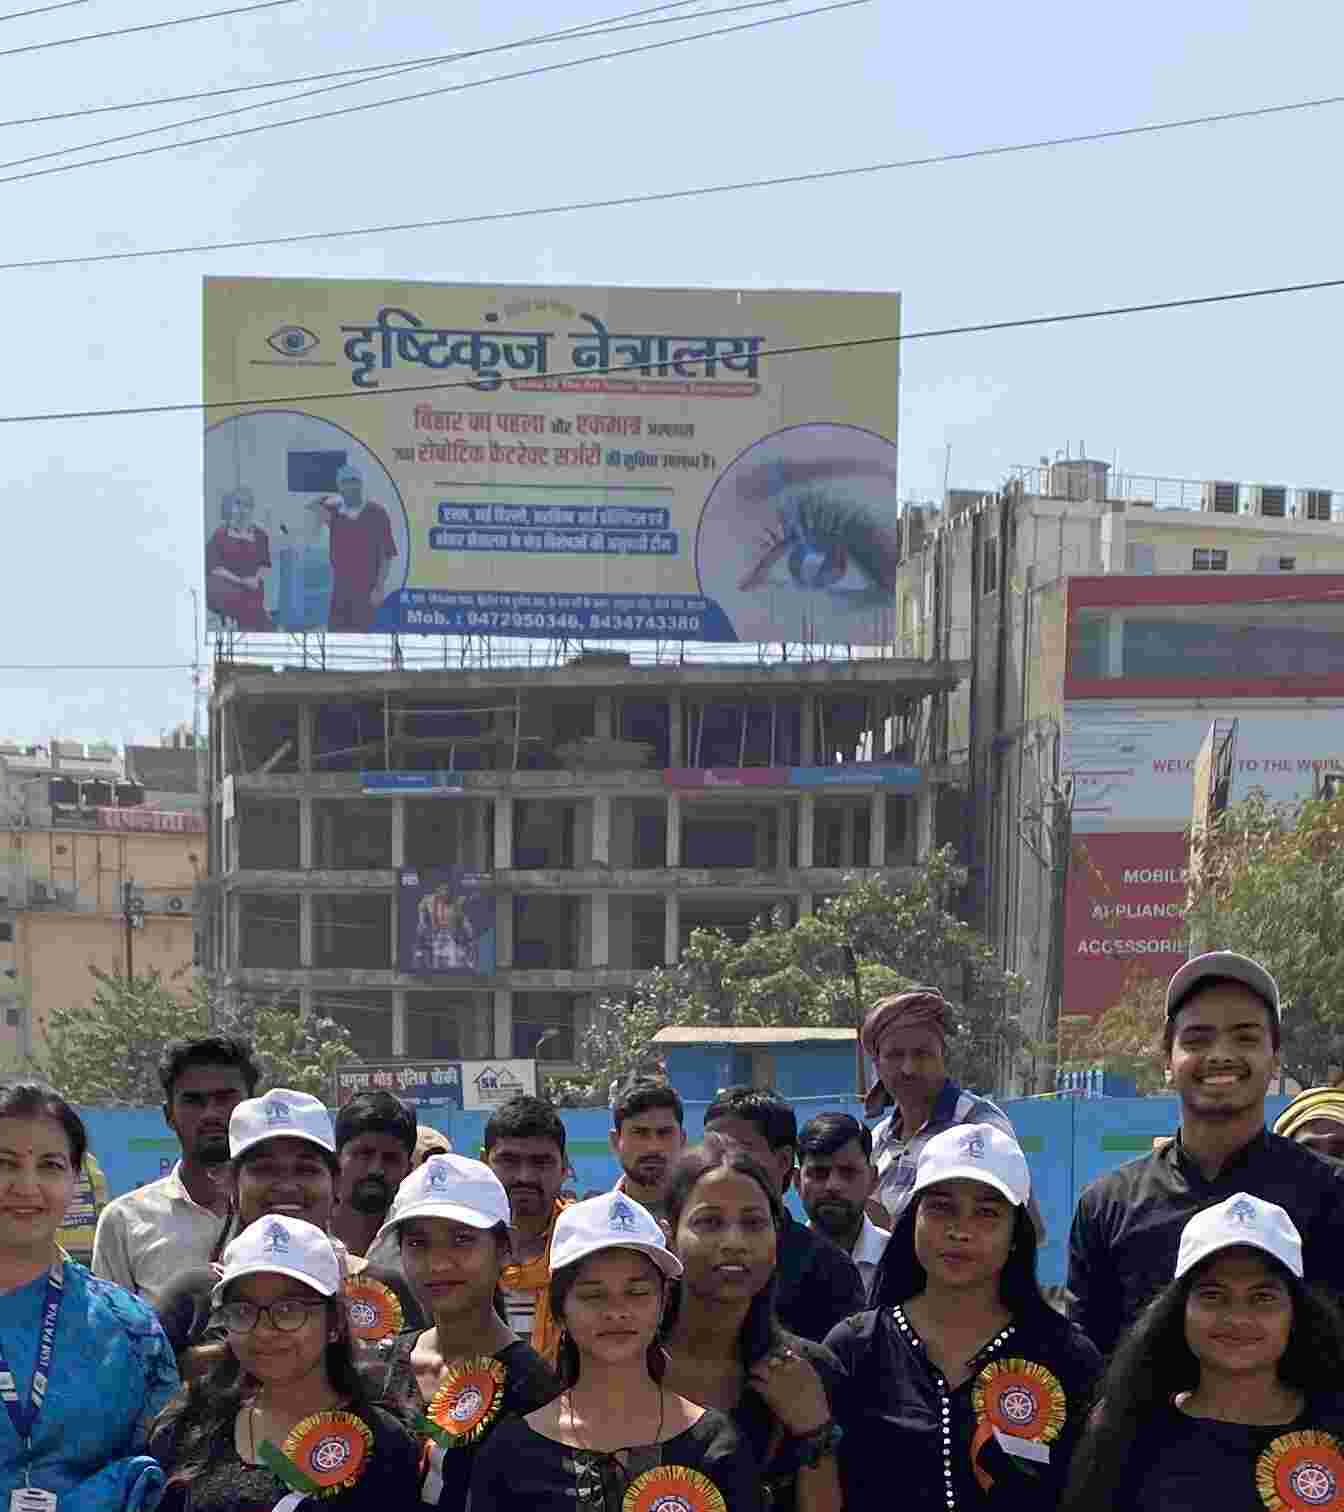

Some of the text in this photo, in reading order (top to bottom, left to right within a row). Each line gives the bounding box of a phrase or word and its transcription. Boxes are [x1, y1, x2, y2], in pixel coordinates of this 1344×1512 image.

[340, 307, 766, 391] दृष्टिकुंज नेत्रालय
[414, 401, 462, 433] बिहार
[468, 411, 492, 433] का
[495, 412, 545, 434] पहला
[551, 417, 572, 437] और
[575, 413, 641, 436] एकमात्र
[417, 436, 485, 465] रोबोटिक
[554, 441, 601, 466] सर्जरी
[407, 610, 449, 625] Mob.
[1238, 759, 1260, 772] TO
[1263, 759, 1293, 772] THE
[397, 1065, 427, 1091] पुलिस
[40, 1302, 59, 1367] ISM PATNA
